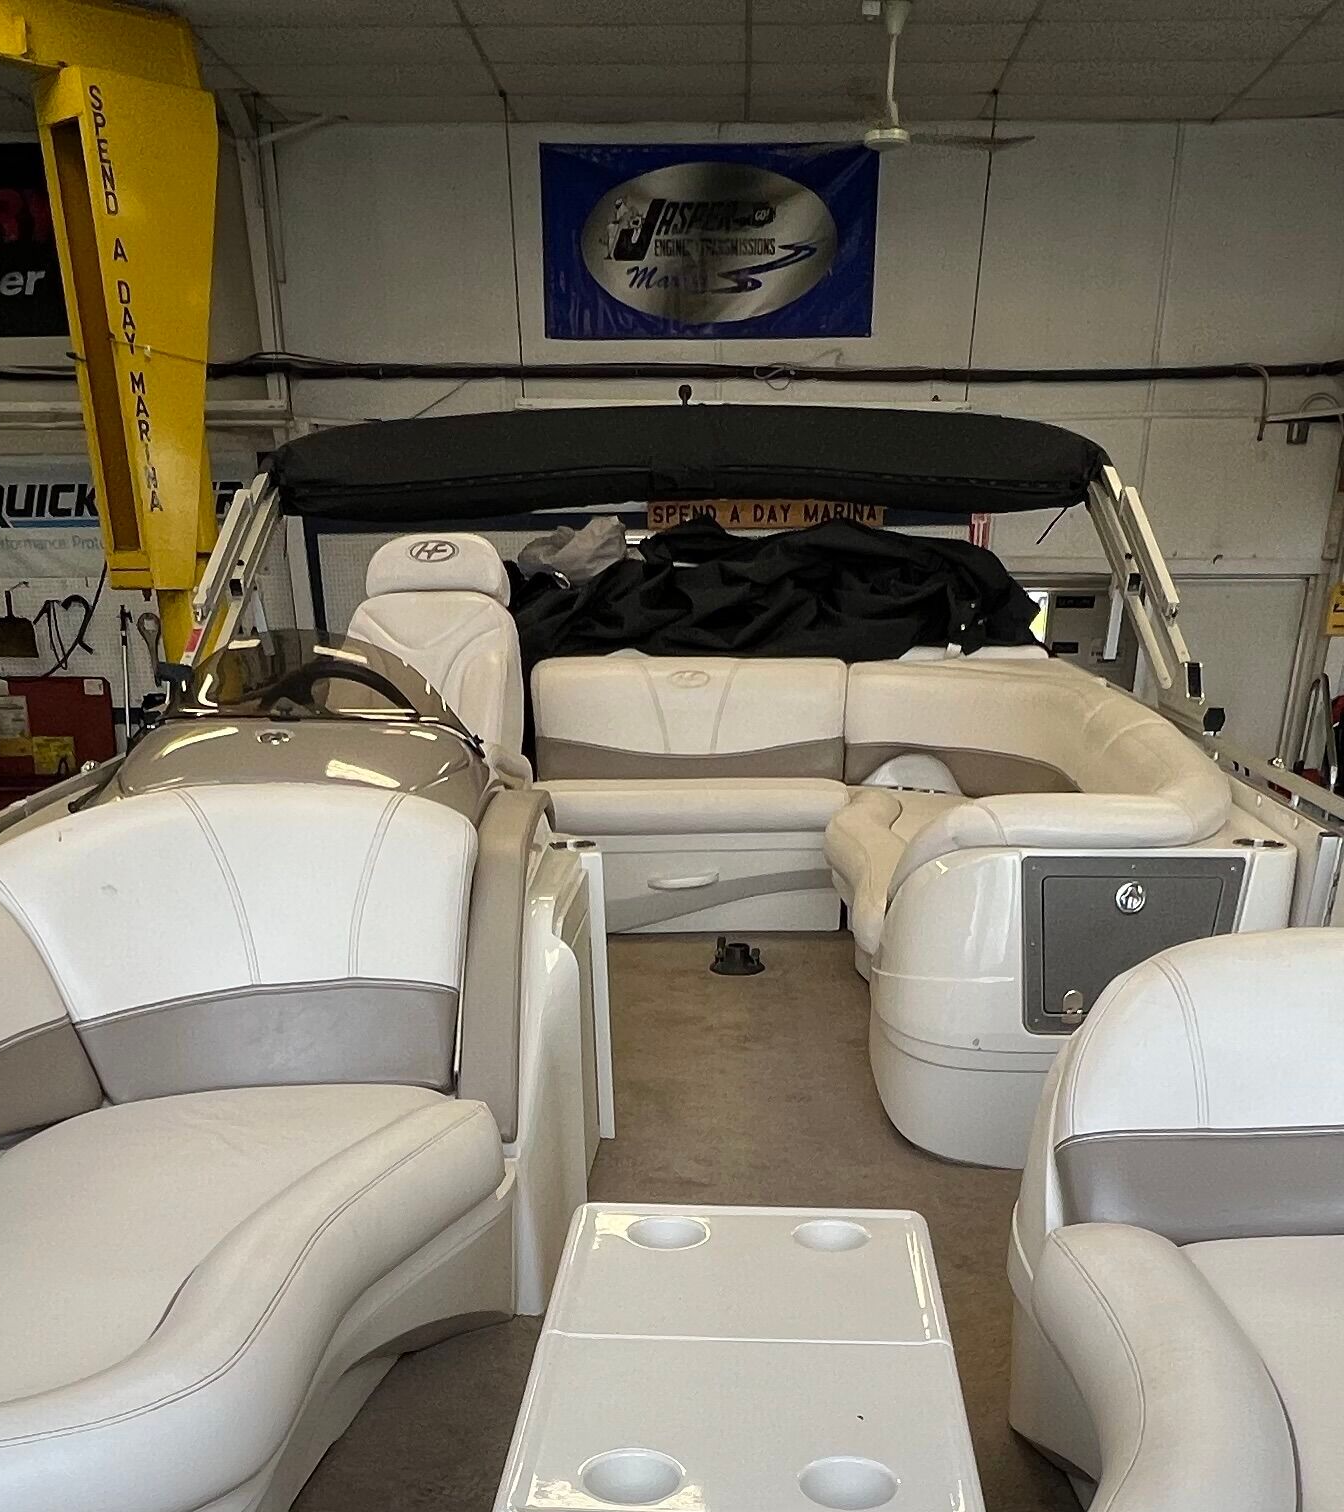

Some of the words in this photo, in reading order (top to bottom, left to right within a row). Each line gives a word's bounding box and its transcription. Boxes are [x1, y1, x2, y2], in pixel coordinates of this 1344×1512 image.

[89, 85, 120, 216] SPEND
[113, 237, 129, 262] A
[117, 280, 136, 355] DAY
[652, 503, 717, 524] SPEND
[729, 504, 741, 523] A
[754, 503, 792, 523] DAY
[803, 503, 878, 523] MARINA
